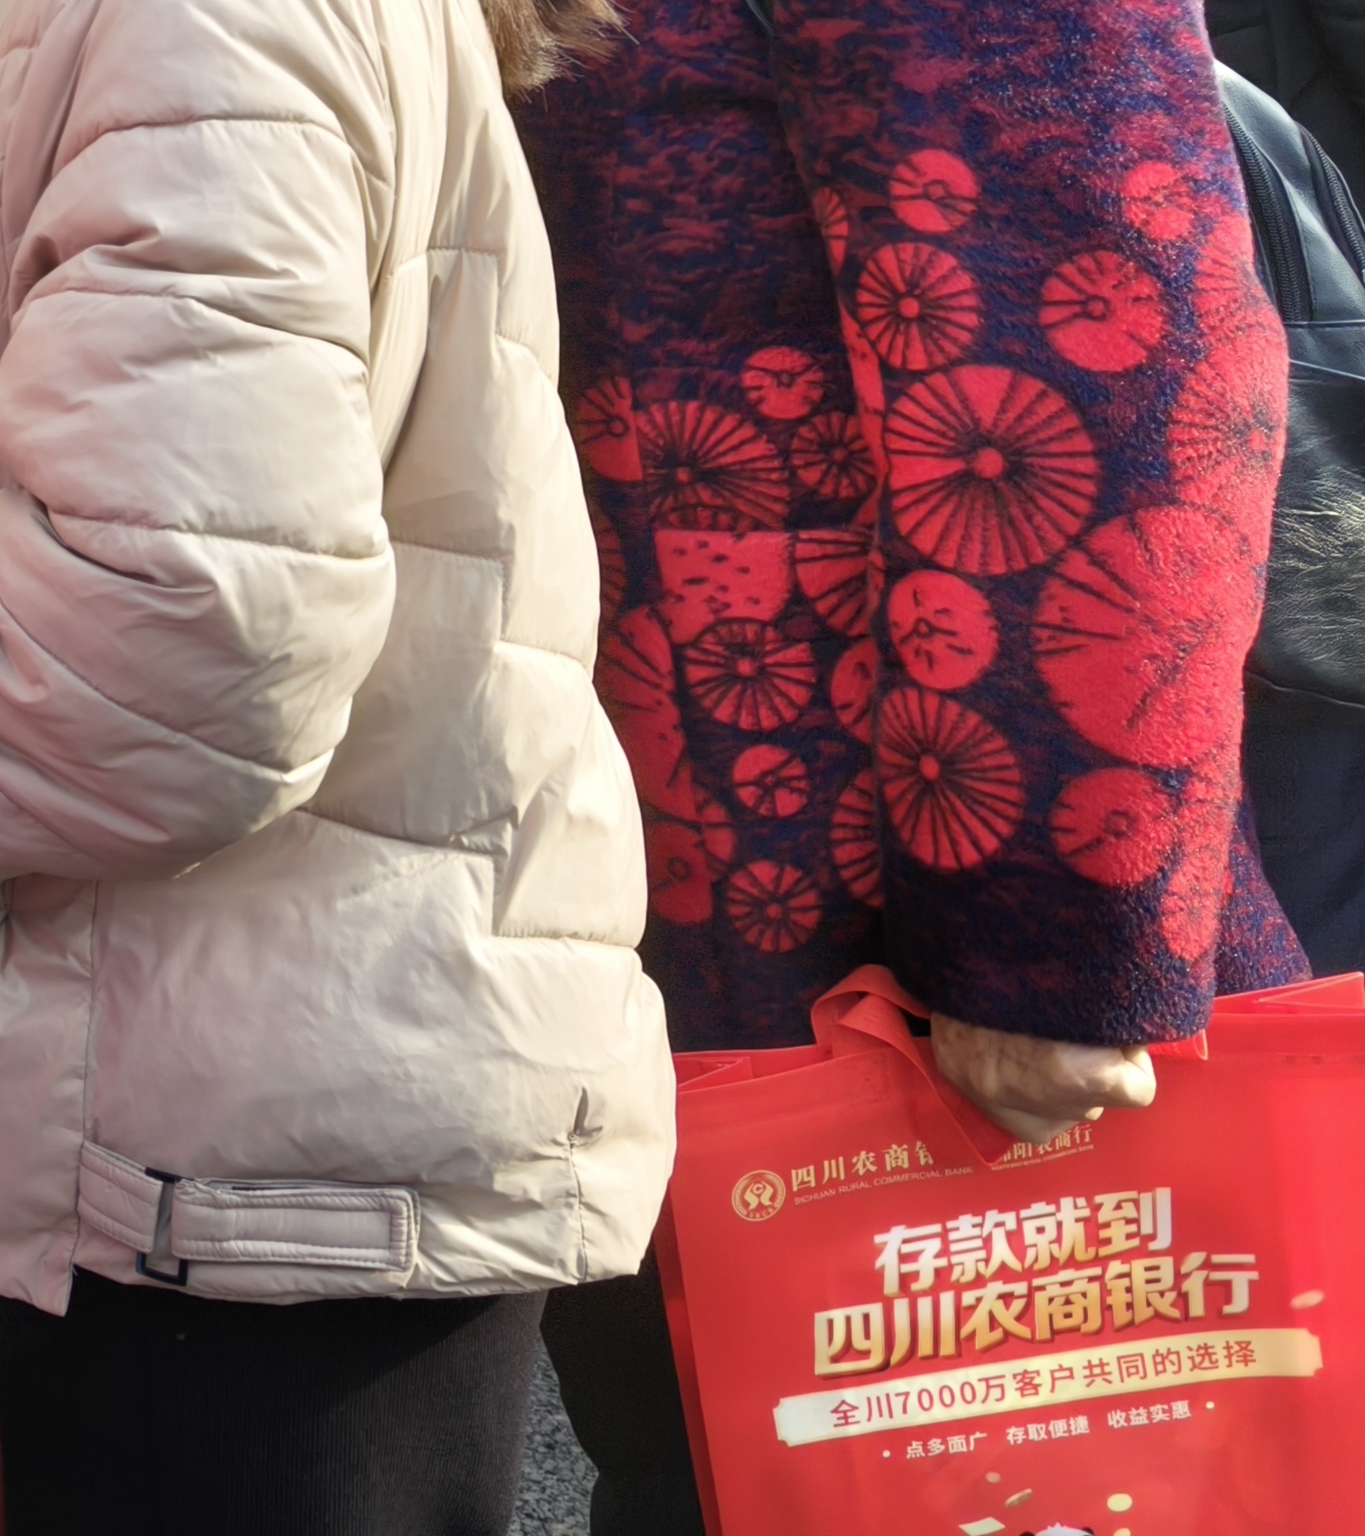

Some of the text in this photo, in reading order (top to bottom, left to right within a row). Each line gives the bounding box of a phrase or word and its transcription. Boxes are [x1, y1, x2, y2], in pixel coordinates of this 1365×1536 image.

[794, 1165, 975, 1206] SICHUAN RURAL COMMERCIAL BANK
[873, 1187, 1173, 1298] 存款就到
[813, 1252, 1260, 1377] 四川农商银行
[829, 1339, 1258, 1429] 全川7000万客户共同的选择
[905, 1399, 1192, 1460] 点多面广 存取便捷 收益实惠
